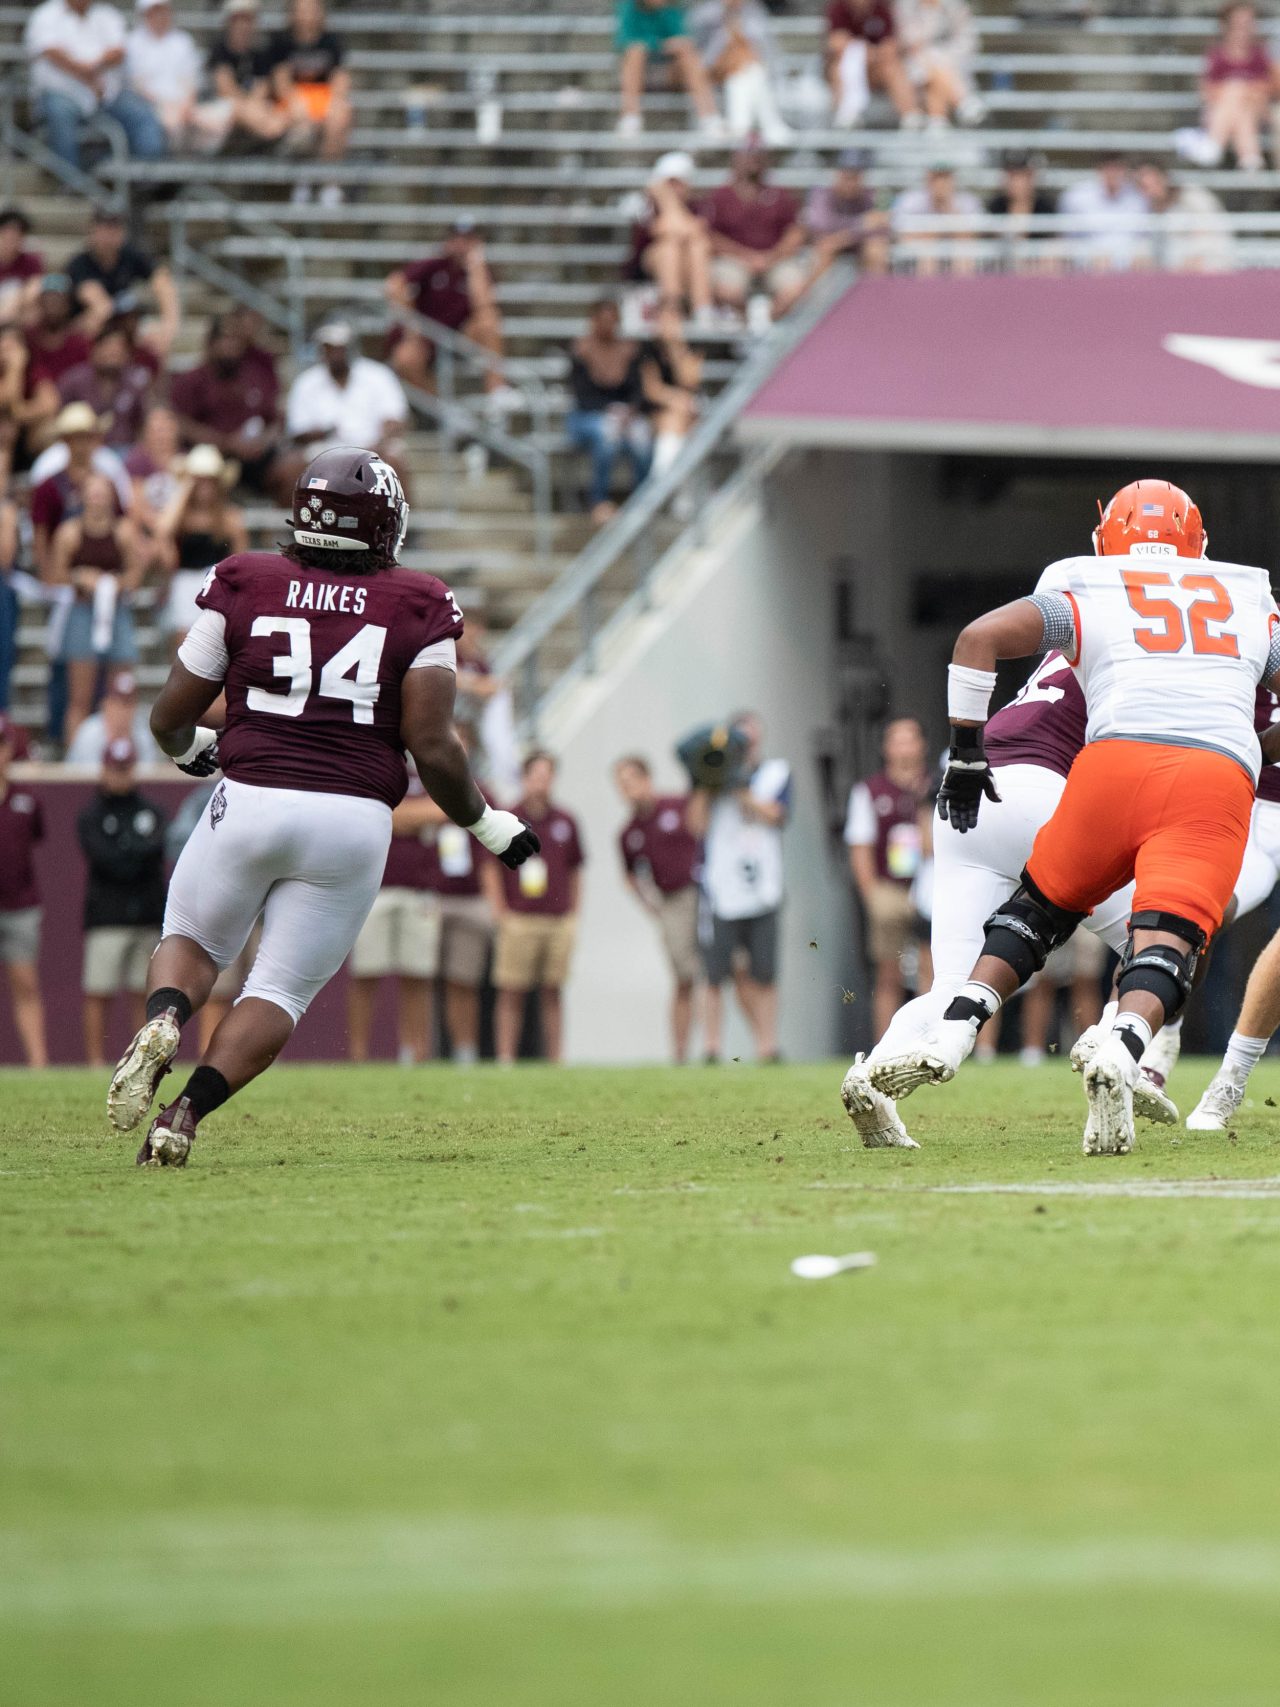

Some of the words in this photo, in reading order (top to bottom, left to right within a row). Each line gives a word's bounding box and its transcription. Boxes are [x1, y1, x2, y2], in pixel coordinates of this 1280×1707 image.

[310, 520, 322, 530] 34
[301, 535, 321, 546] TEXAS
[1136, 546, 1171, 555] VICIS
[286, 580, 368, 615] RAIKES
[1119, 569, 1241, 659] 52
[246, 616, 388, 725] 34
